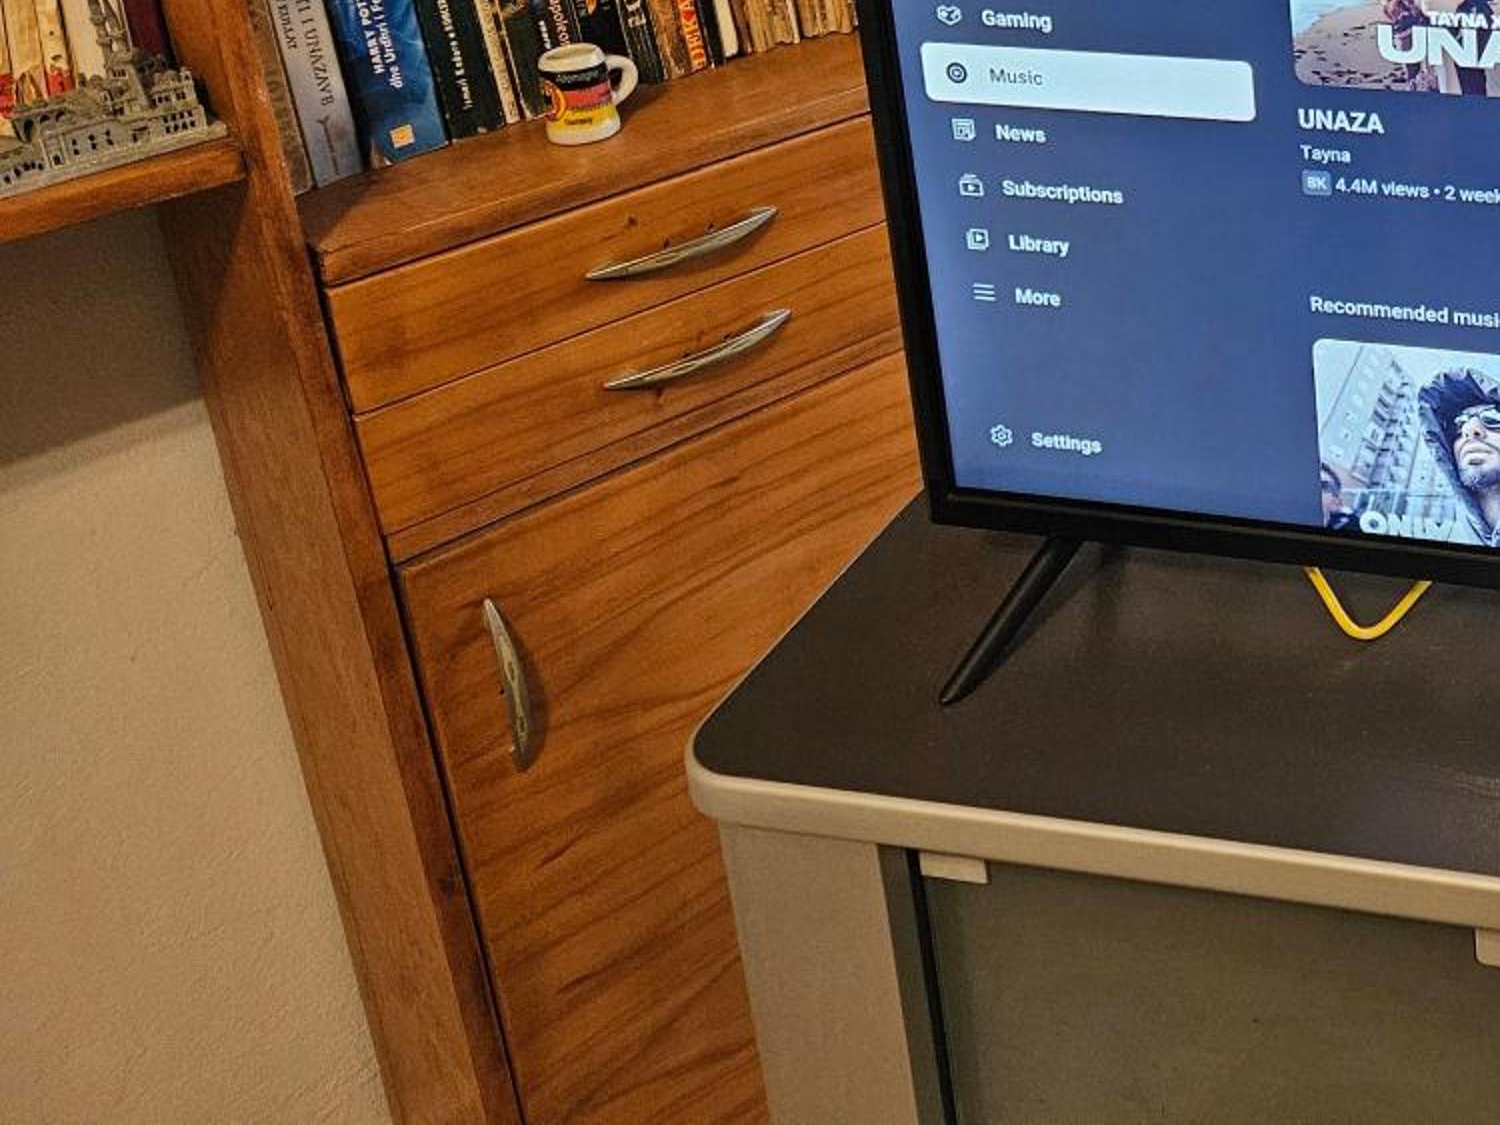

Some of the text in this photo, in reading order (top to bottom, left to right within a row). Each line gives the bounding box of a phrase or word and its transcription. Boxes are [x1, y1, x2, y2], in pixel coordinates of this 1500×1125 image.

[981, 10, 1053, 33] Gaming
[1429, 11, 1488, 28] TAYNA
[365, 31, 386, 75] HARRY
[387, 64, 405, 89] dhe
[989, 68, 1042, 86] Music
[1298, 108, 1385, 134] UNAZA
[995, 124, 1046, 143] News
[1300, 144, 1351, 164] Tayna
[1002, 180, 1123, 204] Subscriptions
[1335, 178, 1378, 195] 4.4M
[1381, 183, 1430, 198] views
[1008, 235, 1069, 257] Library
[1015, 289, 1061, 306] More
[1310, 297, 1449, 324] Recommended
[1031, 433, 1102, 455] Settings
